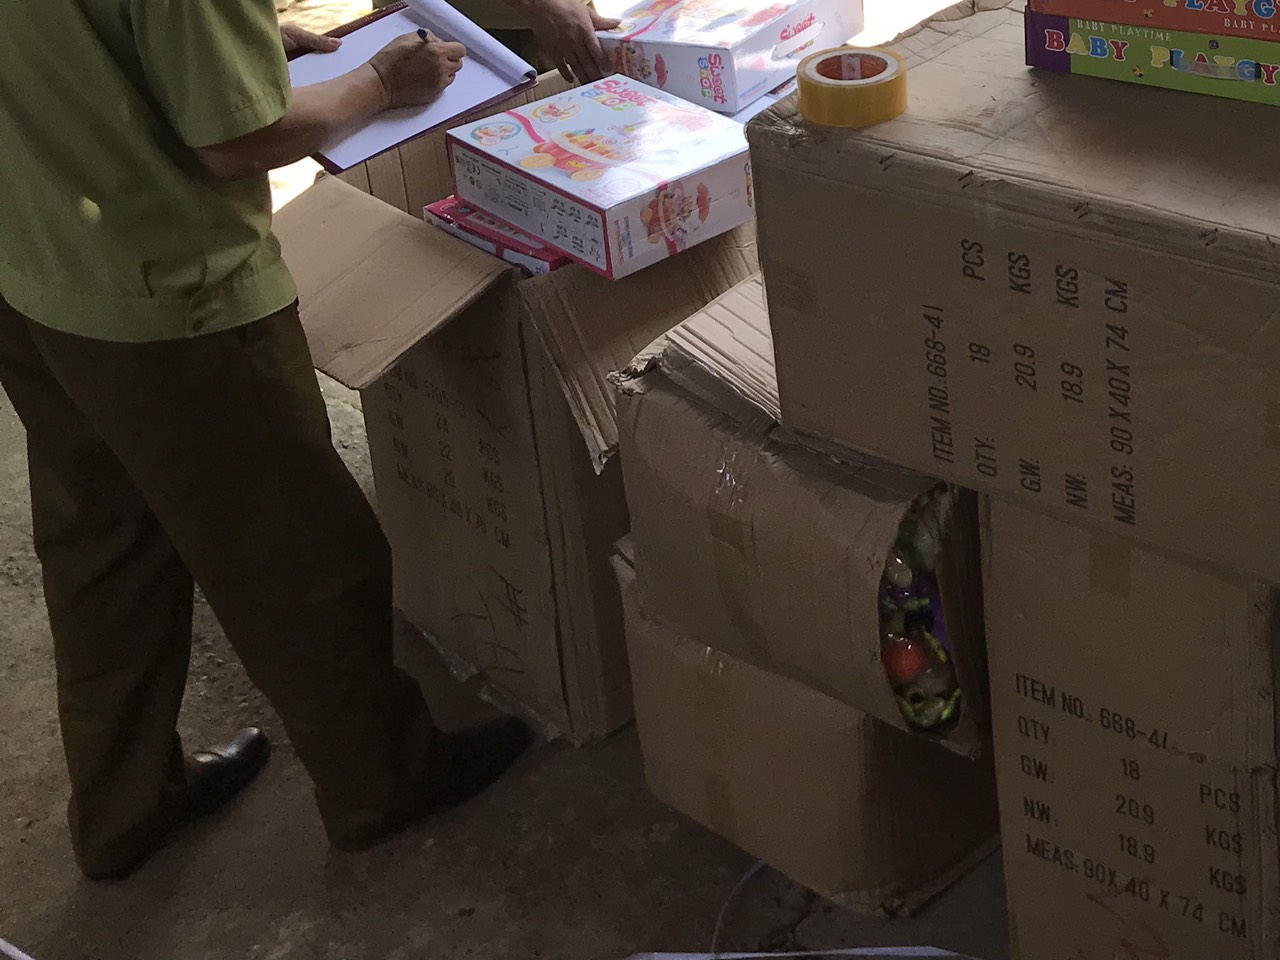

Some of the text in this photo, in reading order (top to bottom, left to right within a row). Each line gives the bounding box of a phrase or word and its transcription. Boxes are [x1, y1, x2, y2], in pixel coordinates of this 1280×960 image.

[1111, 24, 1172, 42] PLAYTIME
[1223, 17, 1255, 30] BABY
[1045, 29, 1129, 62] BABY
[960, 238, 985, 282] PCS
[1055, 264, 1080, 308] KGS
[1103, 276, 1128, 313] CM
[1007, 251, 1039, 392] 20.9 KGS
[1104, 322, 1130, 353] 74
[968, 342, 992, 364] 18
[1060, 361, 1085, 404] 18.9
[930, 417, 955, 464] ITEM
[481, 467, 505, 493] KGS
[1111, 463, 1137, 526] MEAS:
[486, 497, 508, 522] KGS
[1015, 673, 1056, 709] ITEM
[1099, 707, 1169, 750] 668-41
[1120, 757, 1241, 814] 18 PCS
[1205, 824, 1244, 855] KGS
[1118, 833, 1247, 896] 18.9 KGS
[1125, 876, 1150, 902] 40
[1179, 894, 1204, 922] 74
[1218, 911, 1248, 939] CM
